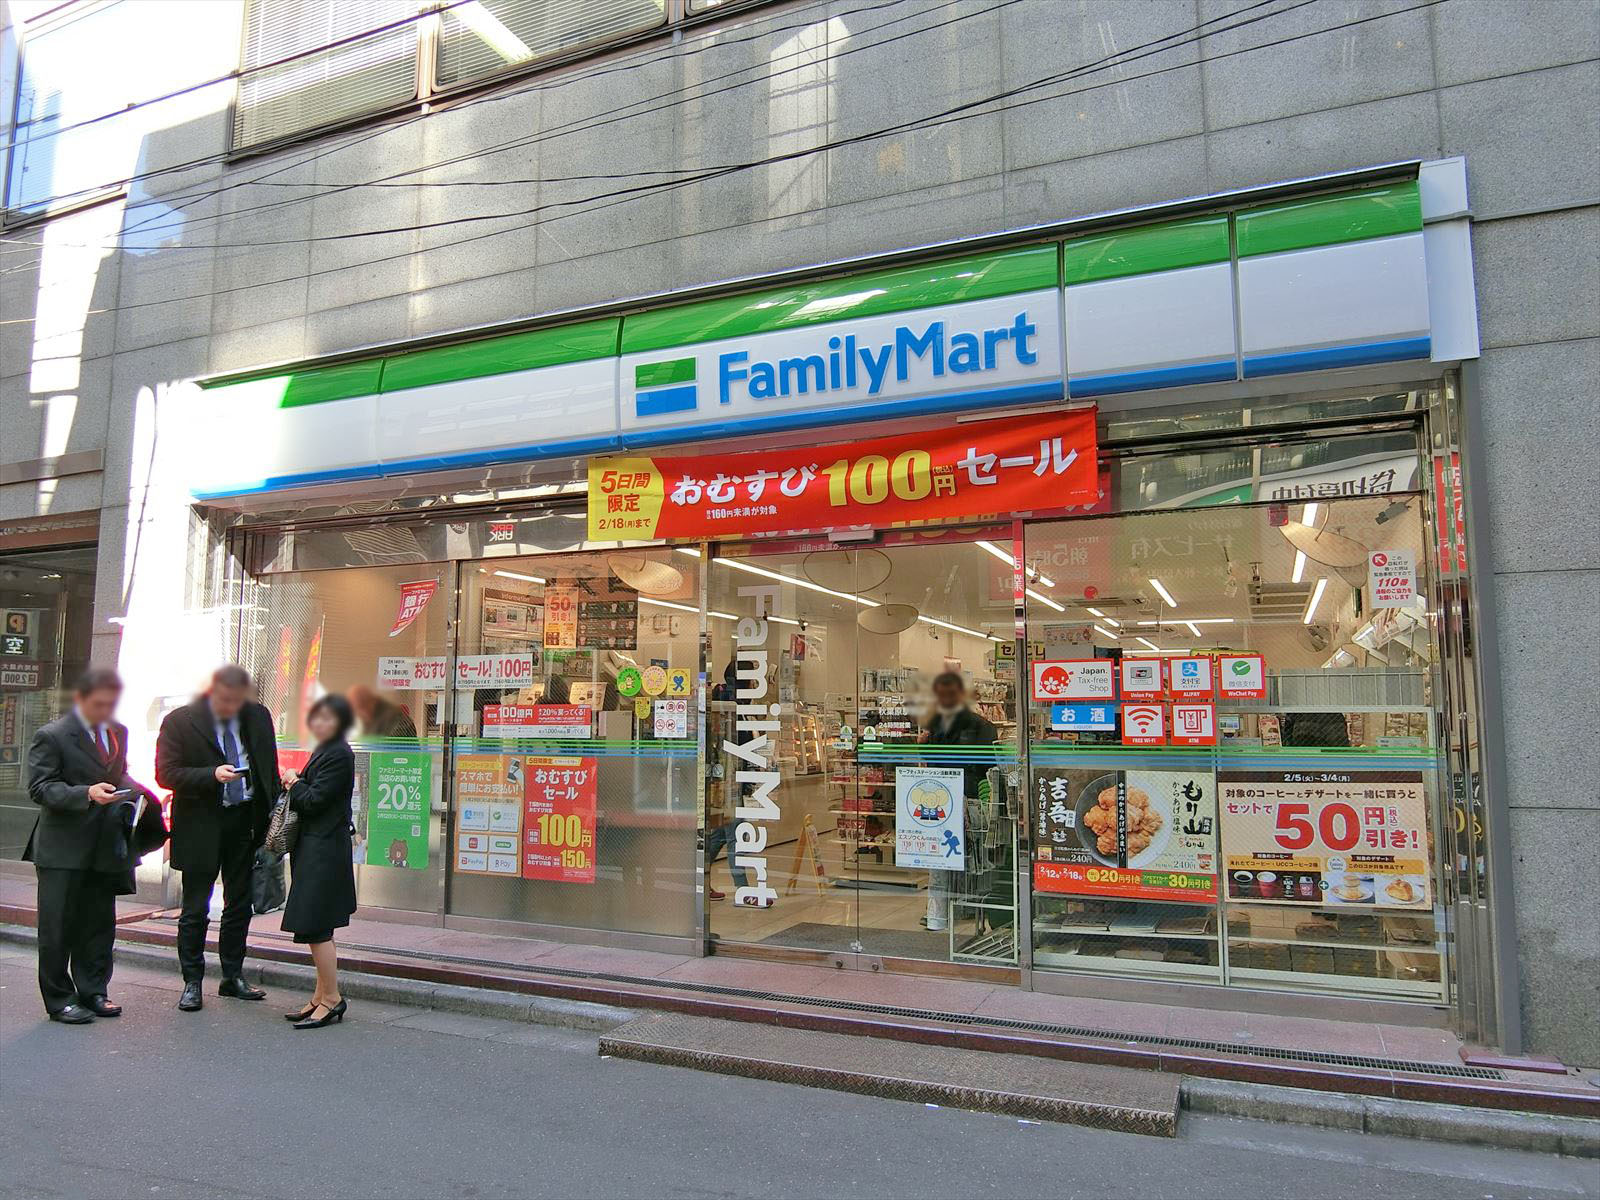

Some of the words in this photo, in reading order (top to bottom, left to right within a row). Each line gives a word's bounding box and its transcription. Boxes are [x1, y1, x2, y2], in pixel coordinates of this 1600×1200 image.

[718, 311, 1038, 404] FamilyMart
[669, 463, 819, 507] おむすび
[956, 437, 1079, 486] セール
[600, 470, 651, 493] 5日間
[607, 493, 640, 513] 限定
[1077, 676, 1109, 684] Tax-free
[1080, 667, 1108, 676] Japan.
[1088, 684, 1109, 693] Shop
[722, 584, 782, 909] FamilyMart
[534, 768, 588, 785] おむすび
[543, 785, 579, 800] セール
[1225, 788, 1416, 800] 対象のコーヒーとデザートを一緒に買うと
[1180, 780, 1203, 835] もり山
[1226, 802, 1273, 814] セットで
